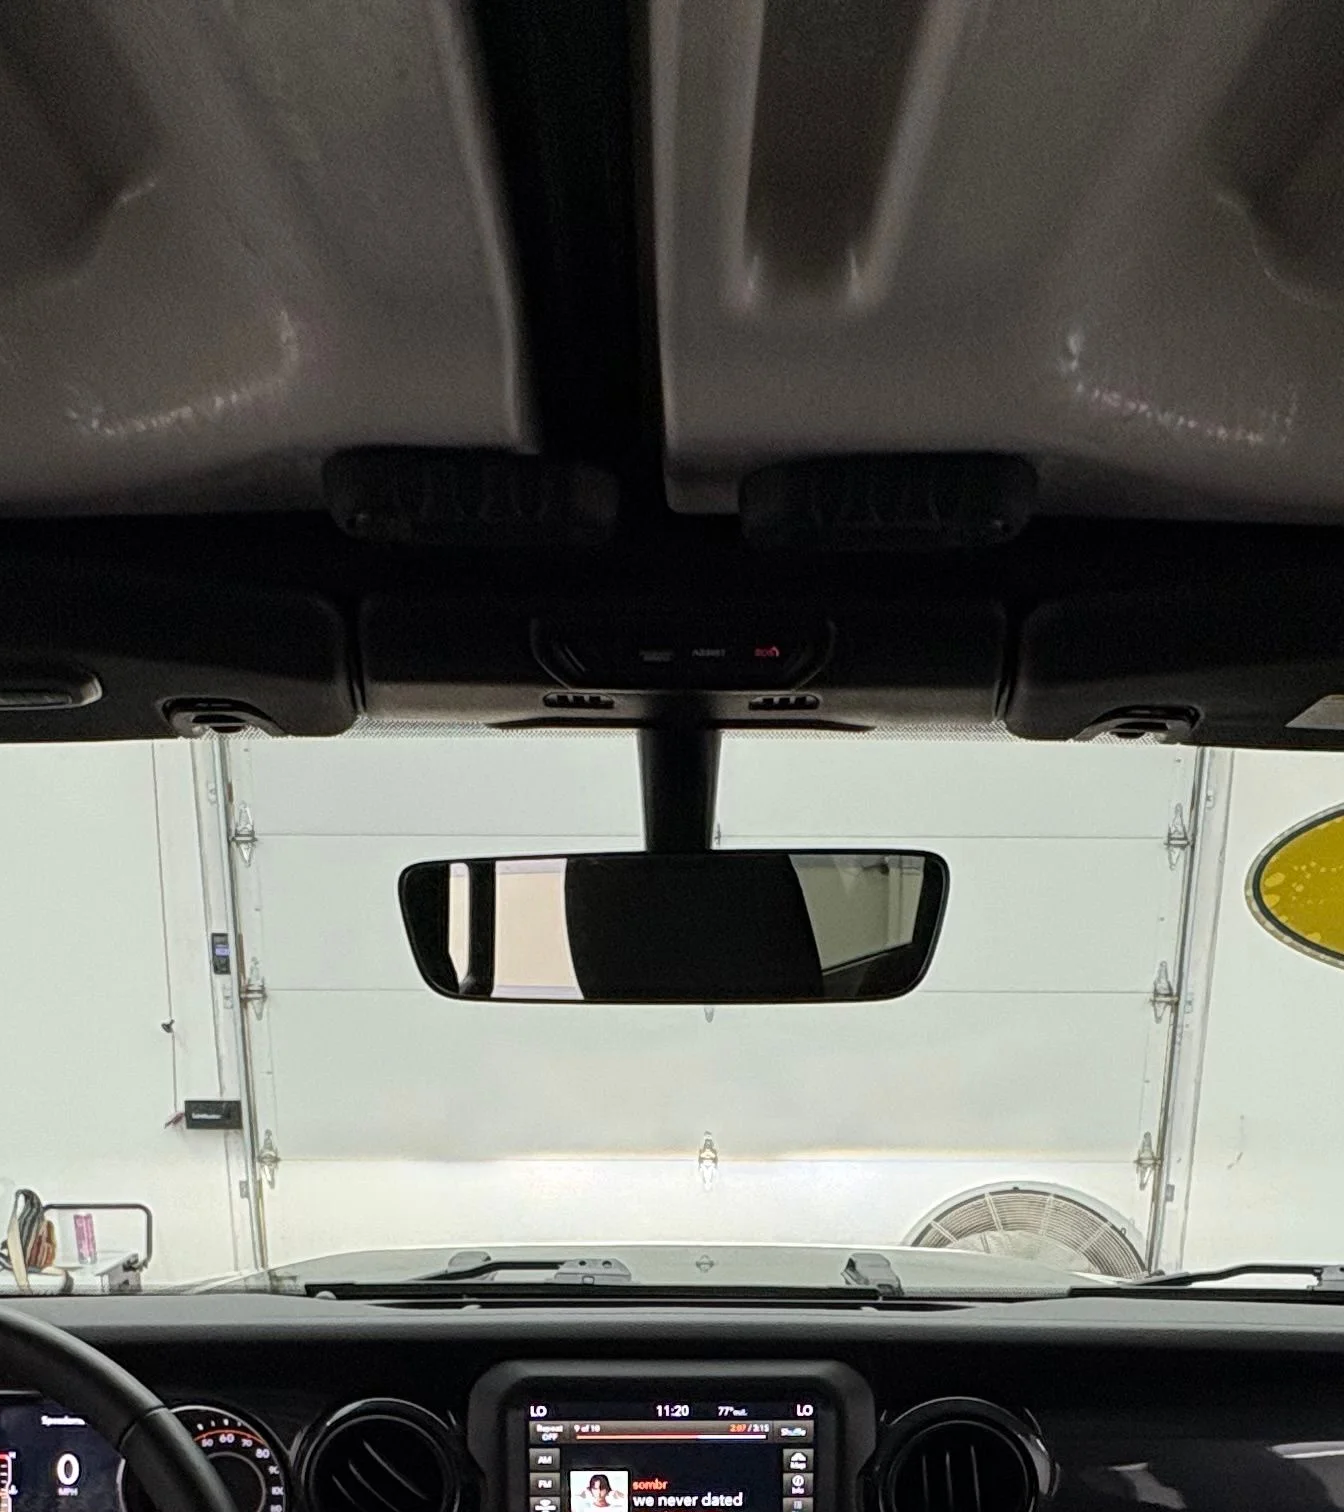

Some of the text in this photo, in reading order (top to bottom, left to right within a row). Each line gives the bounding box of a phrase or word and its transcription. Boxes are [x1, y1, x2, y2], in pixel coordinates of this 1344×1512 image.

[530, 1406, 548, 1418] LO
[656, 1405, 690, 1418] 11:20
[796, 1404, 814, 1417] LO
[581, 1424, 590, 1432] of
[220, 1434, 236, 1444] 60
[256, 1449, 271, 1458] 80
[537, 1455, 552, 1464] AM
[56, 1452, 80, 1486] 0
[538, 1480, 552, 1489] FM
[632, 1478, 668, 1490] sombr
[57, 1488, 78, 1496] MPH
[632, 1492, 744, 1507] we never dated
